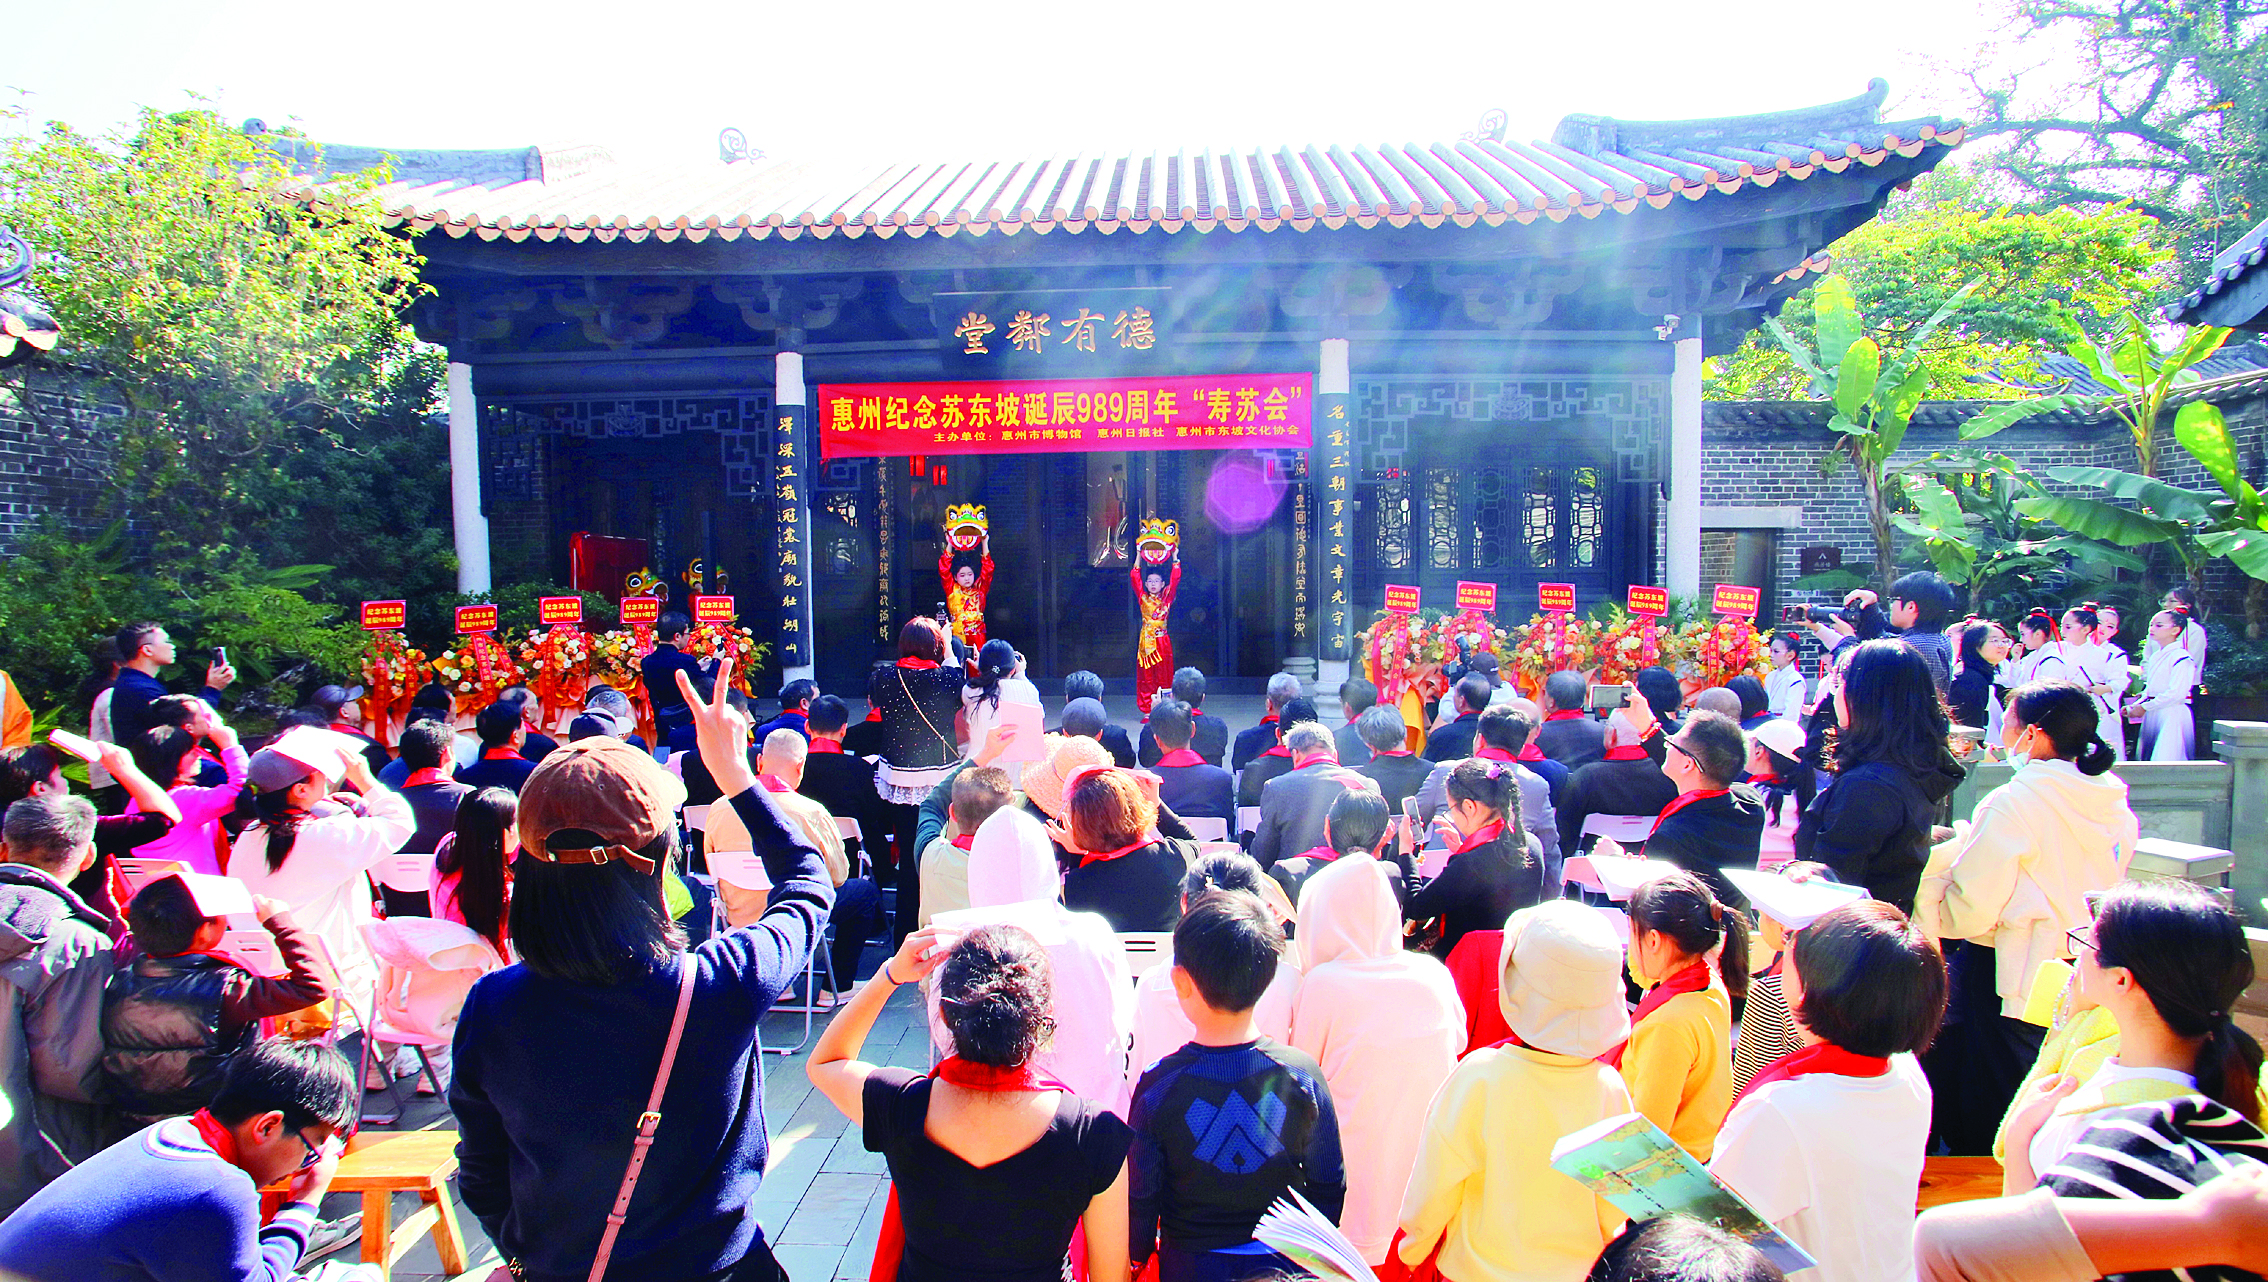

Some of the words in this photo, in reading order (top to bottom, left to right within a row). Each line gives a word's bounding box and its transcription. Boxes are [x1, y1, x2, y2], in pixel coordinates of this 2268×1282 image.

[1097, 426, 1165, 439] 惠州日报社
[1176, 424, 1299, 437] 惠州市东坡文化协会
